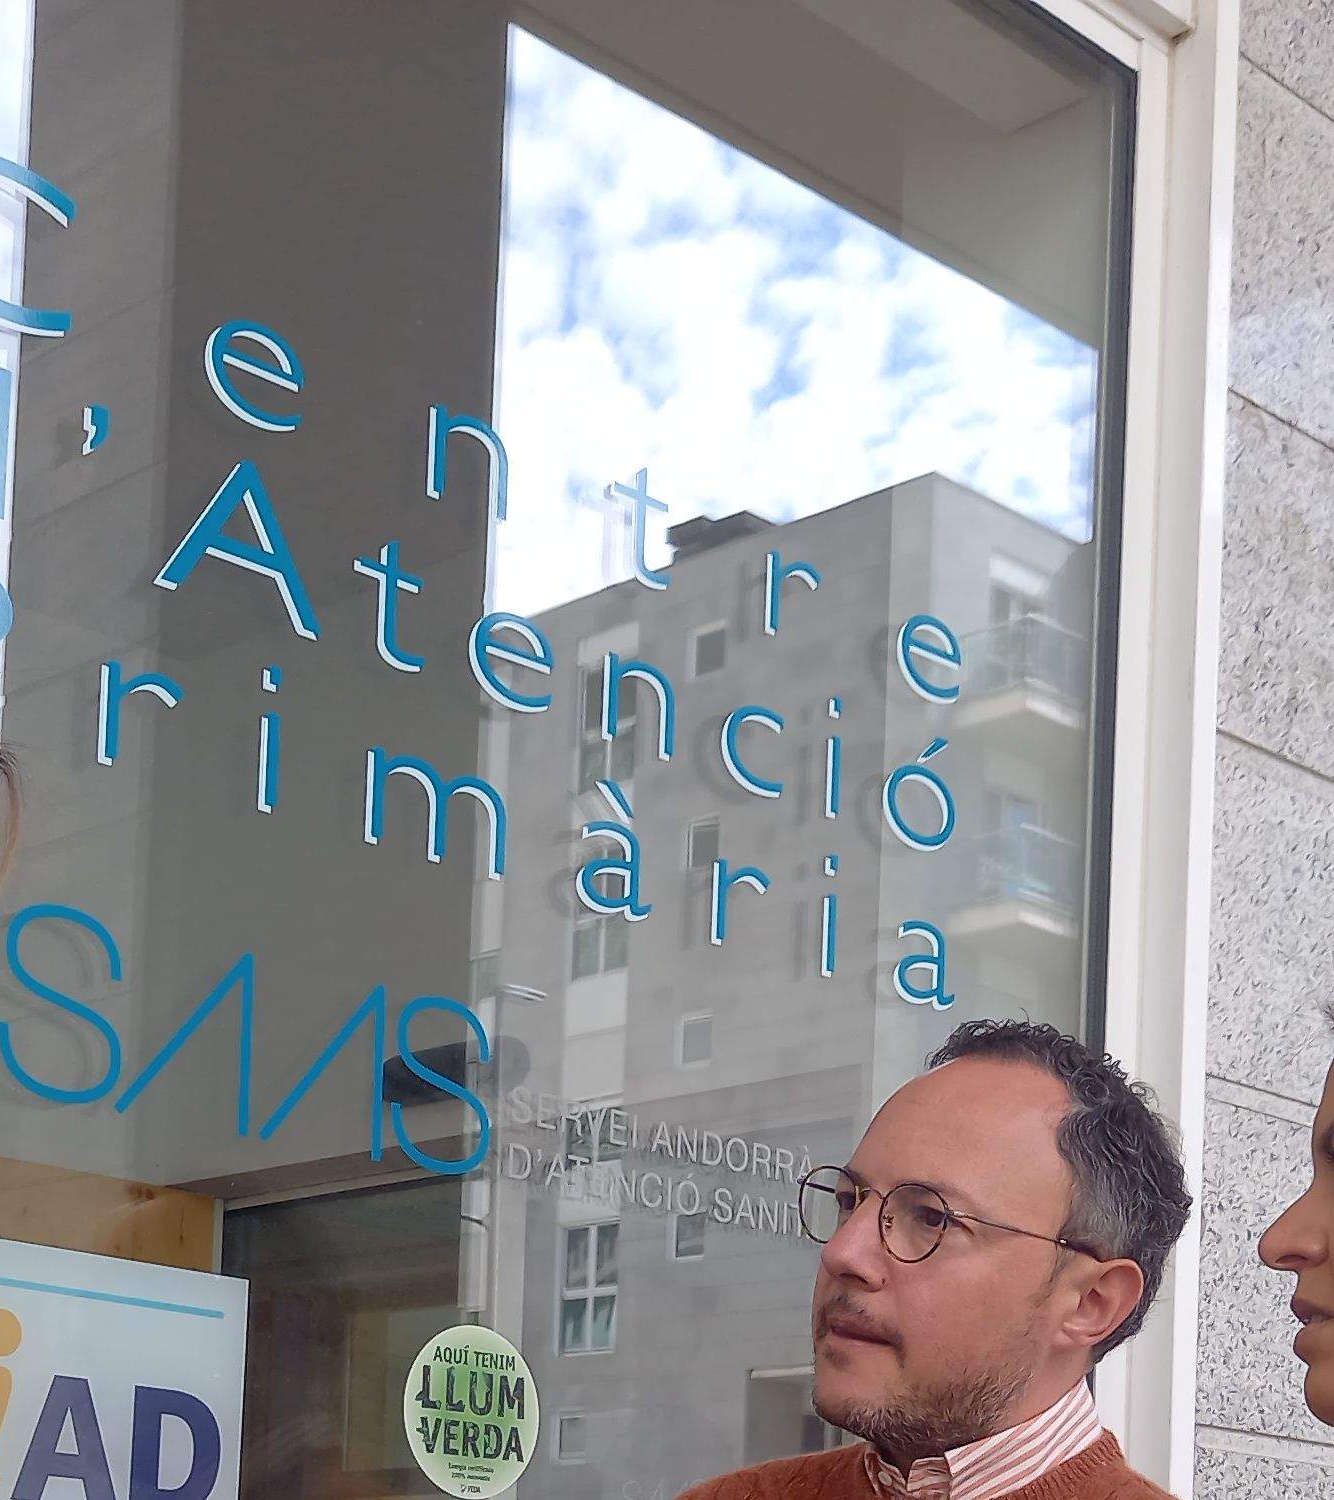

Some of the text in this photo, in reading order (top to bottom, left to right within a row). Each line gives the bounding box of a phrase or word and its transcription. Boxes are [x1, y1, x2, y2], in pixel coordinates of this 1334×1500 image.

[651, 1120, 816, 1185] ANDORRÀ
[433, 1345, 516, 1372] AQUÍ TENIM
[415, 1365, 525, 1420] LLUM
[416, 1416, 525, 1463] VERDA
